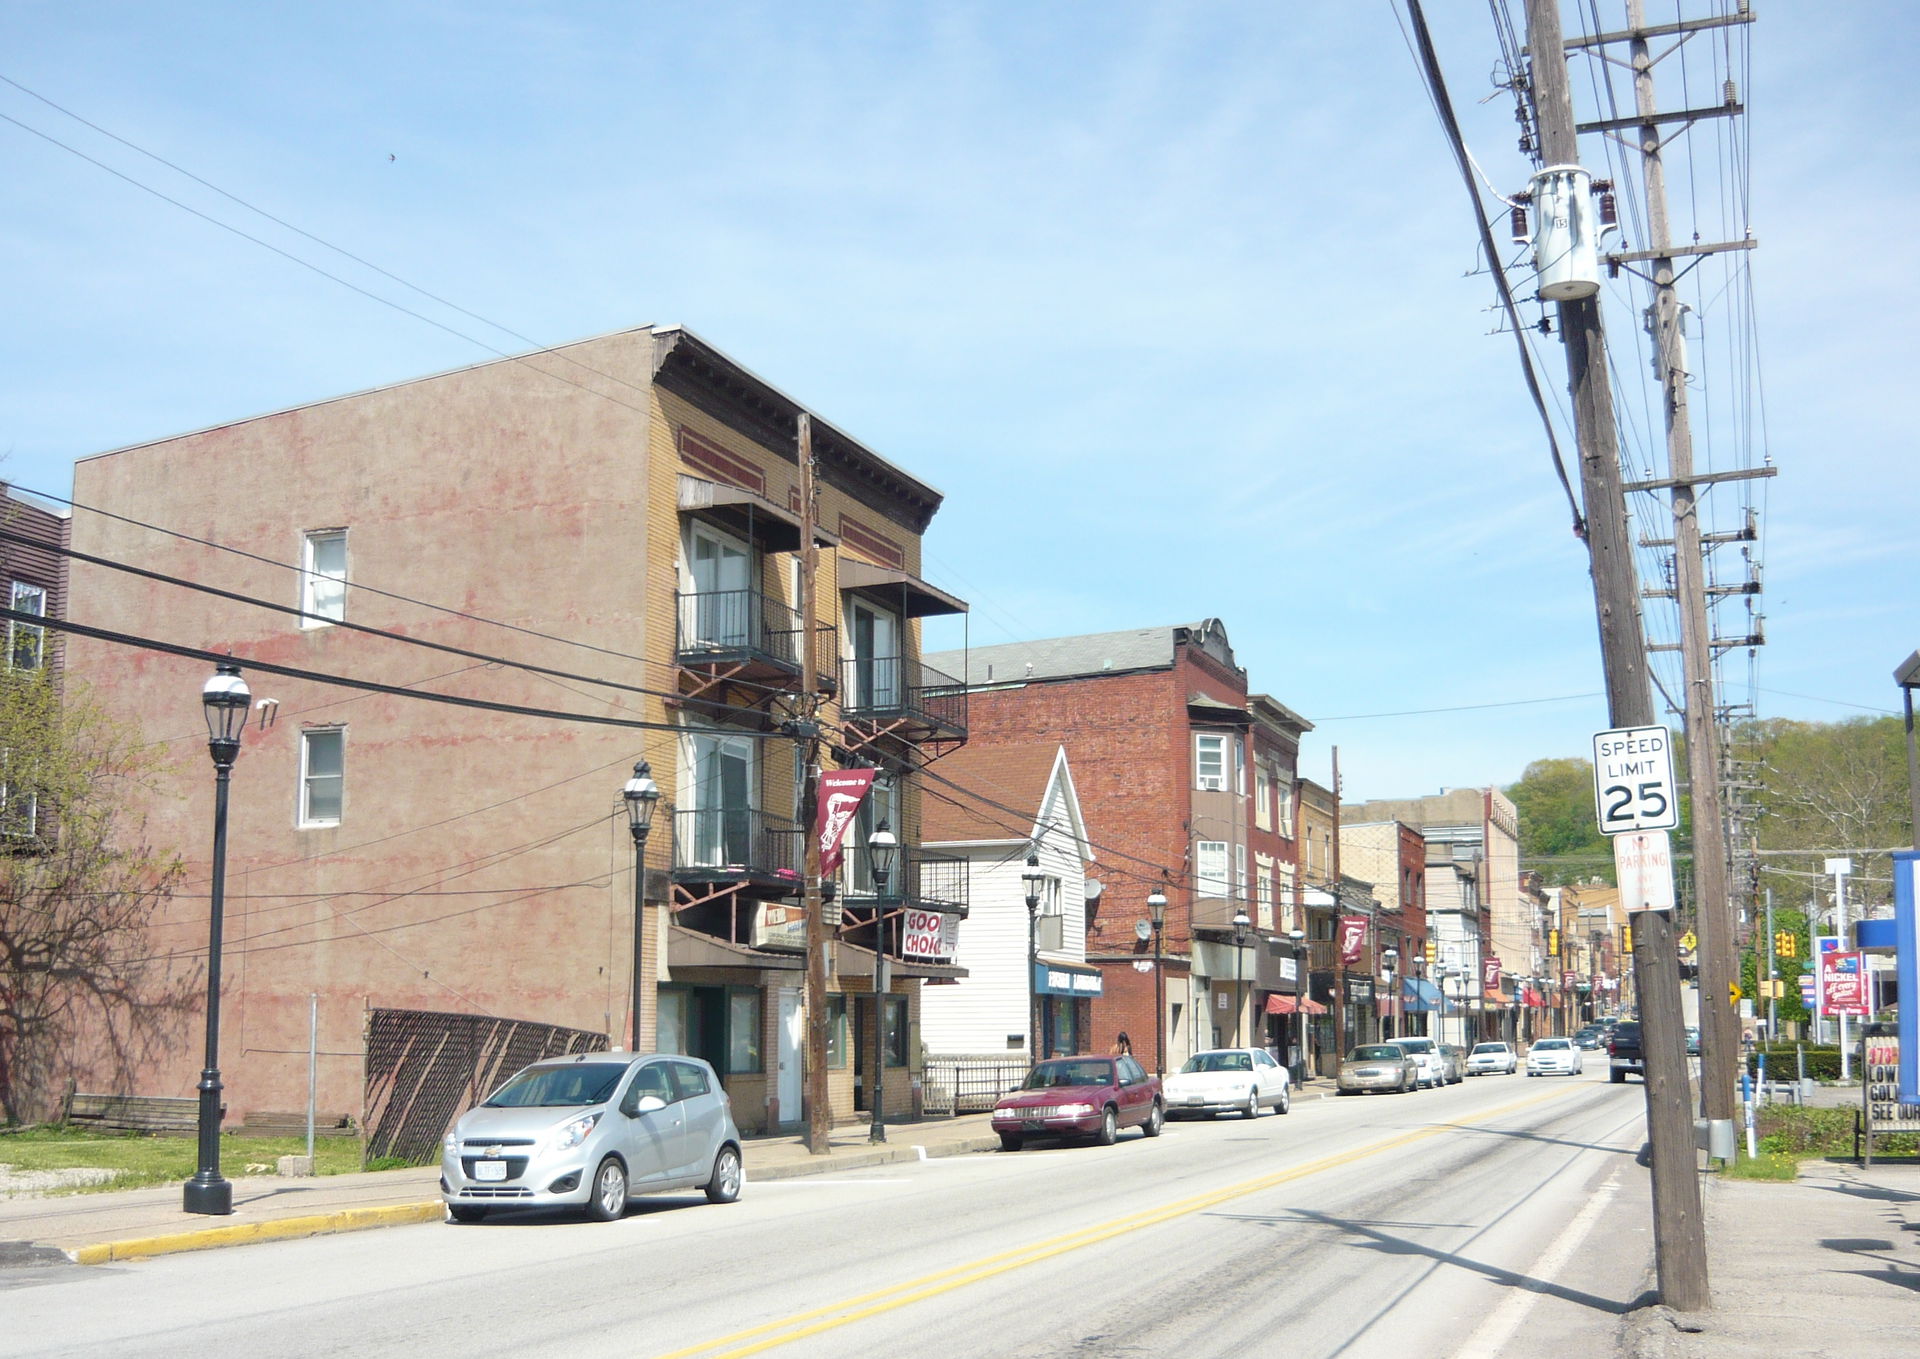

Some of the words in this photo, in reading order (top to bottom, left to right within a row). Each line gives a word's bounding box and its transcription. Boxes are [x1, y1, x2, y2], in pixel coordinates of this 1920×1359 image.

[1601, 738, 1663, 757] SPEED
[1608, 760, 1656, 778] LIMIT
[825, 779, 857, 787] Welcome
[857, 778, 867, 786] to
[1604, 781, 1667, 822] 25
[1632, 836, 1650, 850] NO
[1619, 852, 1667, 869] PARKING
[908, 912, 942, 932] GOO
[1823, 964, 1832, 973] A
[1824, 972, 1859, 982] NICKEL
[1869, 1066, 1896, 1082] LOW
[1872, 1103, 1893, 1120] SEE
